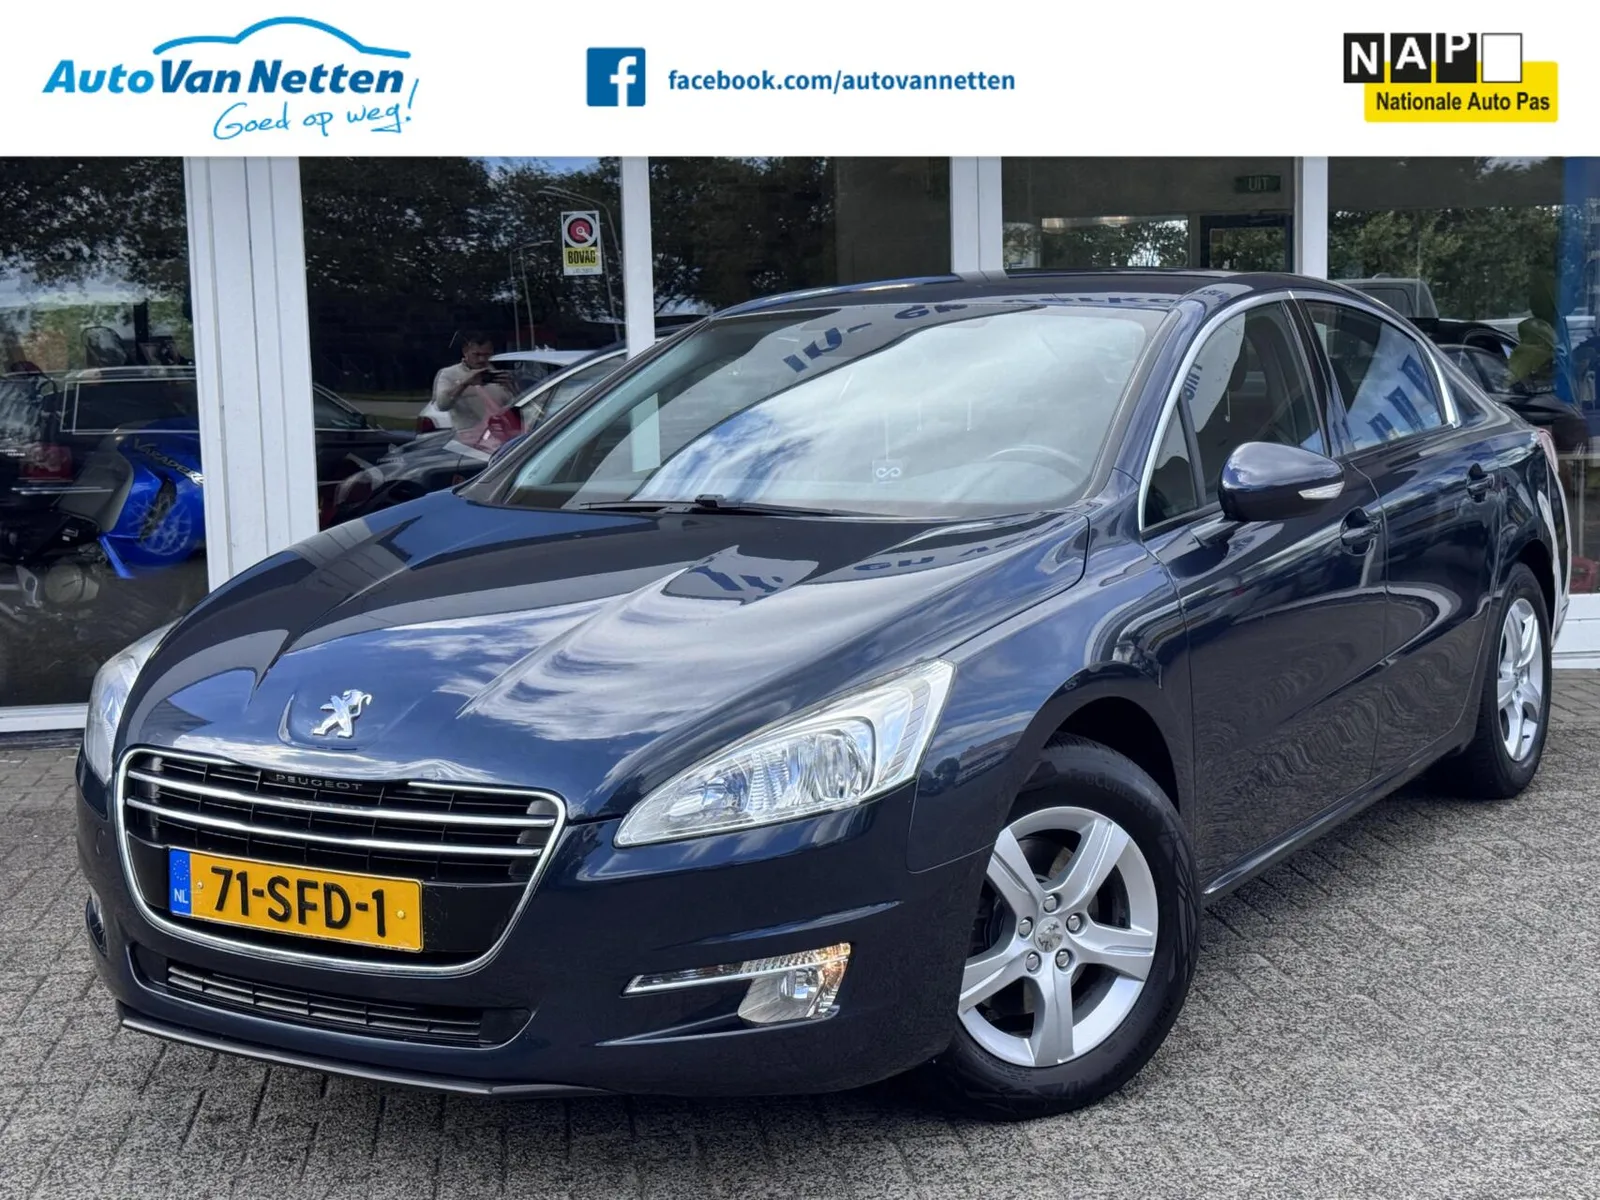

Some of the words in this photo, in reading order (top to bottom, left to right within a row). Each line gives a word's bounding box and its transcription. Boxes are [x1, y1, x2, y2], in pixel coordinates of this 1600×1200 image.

[1248, 176, 1269, 191] UIT
[568, 250, 596, 264] BOVAG
[276, 774, 363, 791] PEUGEOT
[174, 887, 189, 904] NL
[211, 865, 386, 938] 71-SFD-1
